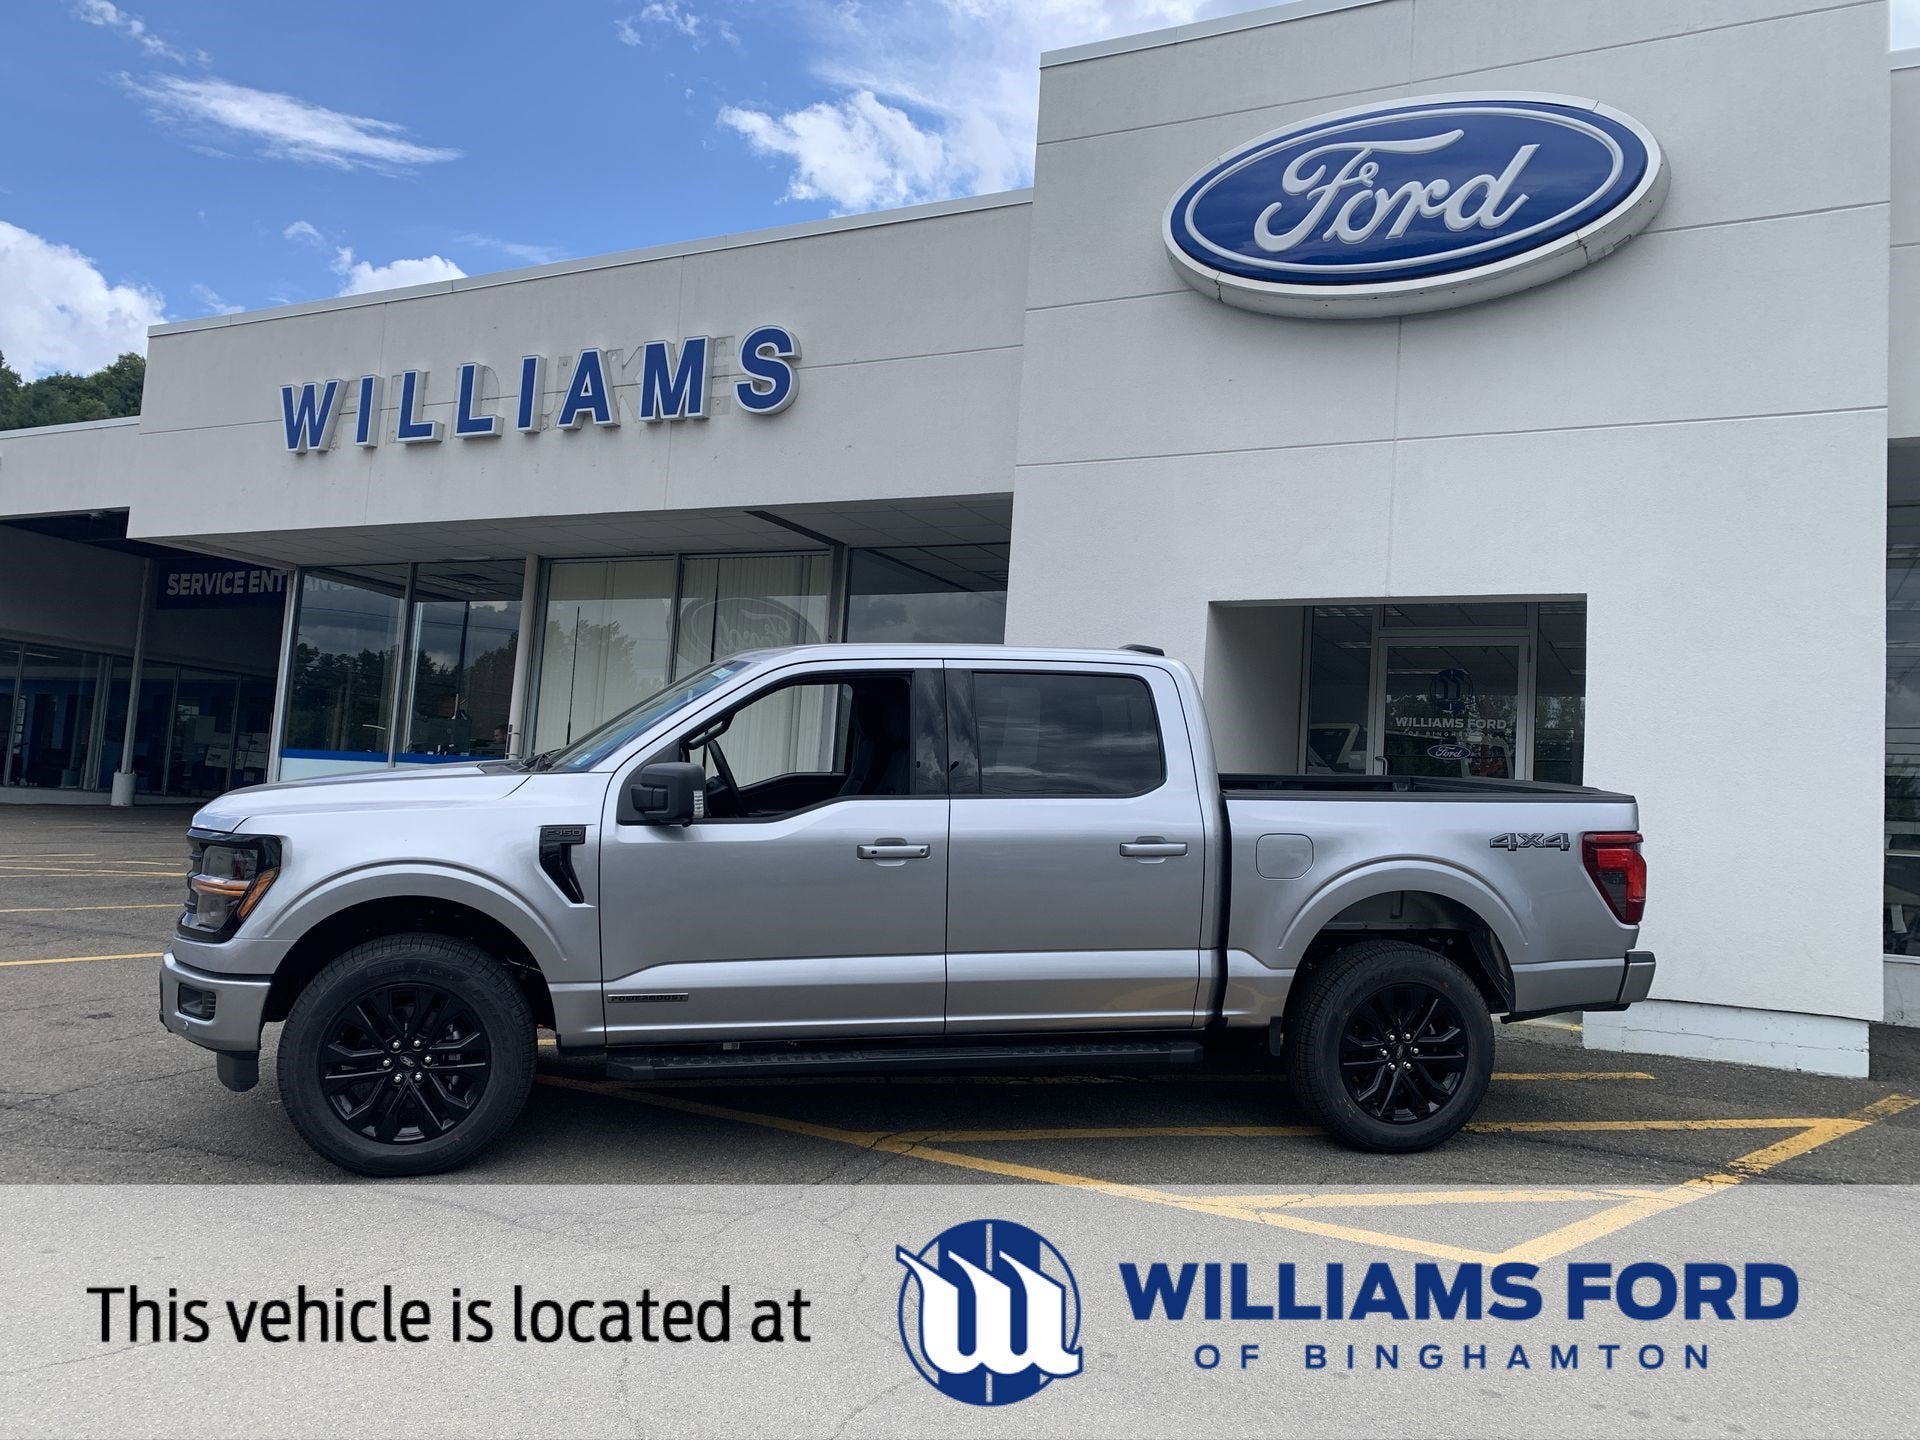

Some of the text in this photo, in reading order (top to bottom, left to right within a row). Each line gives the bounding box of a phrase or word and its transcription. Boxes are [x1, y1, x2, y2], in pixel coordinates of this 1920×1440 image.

[1254, 128, 1540, 253] Ford
[279, 325, 802, 454] WILLIAMS
[166, 571, 246, 596] SERVICE
[1395, 716, 1507, 730] WILLIAMS FORD
[1434, 746, 1462, 758] Ford
[546, 828, 582, 837] F-150
